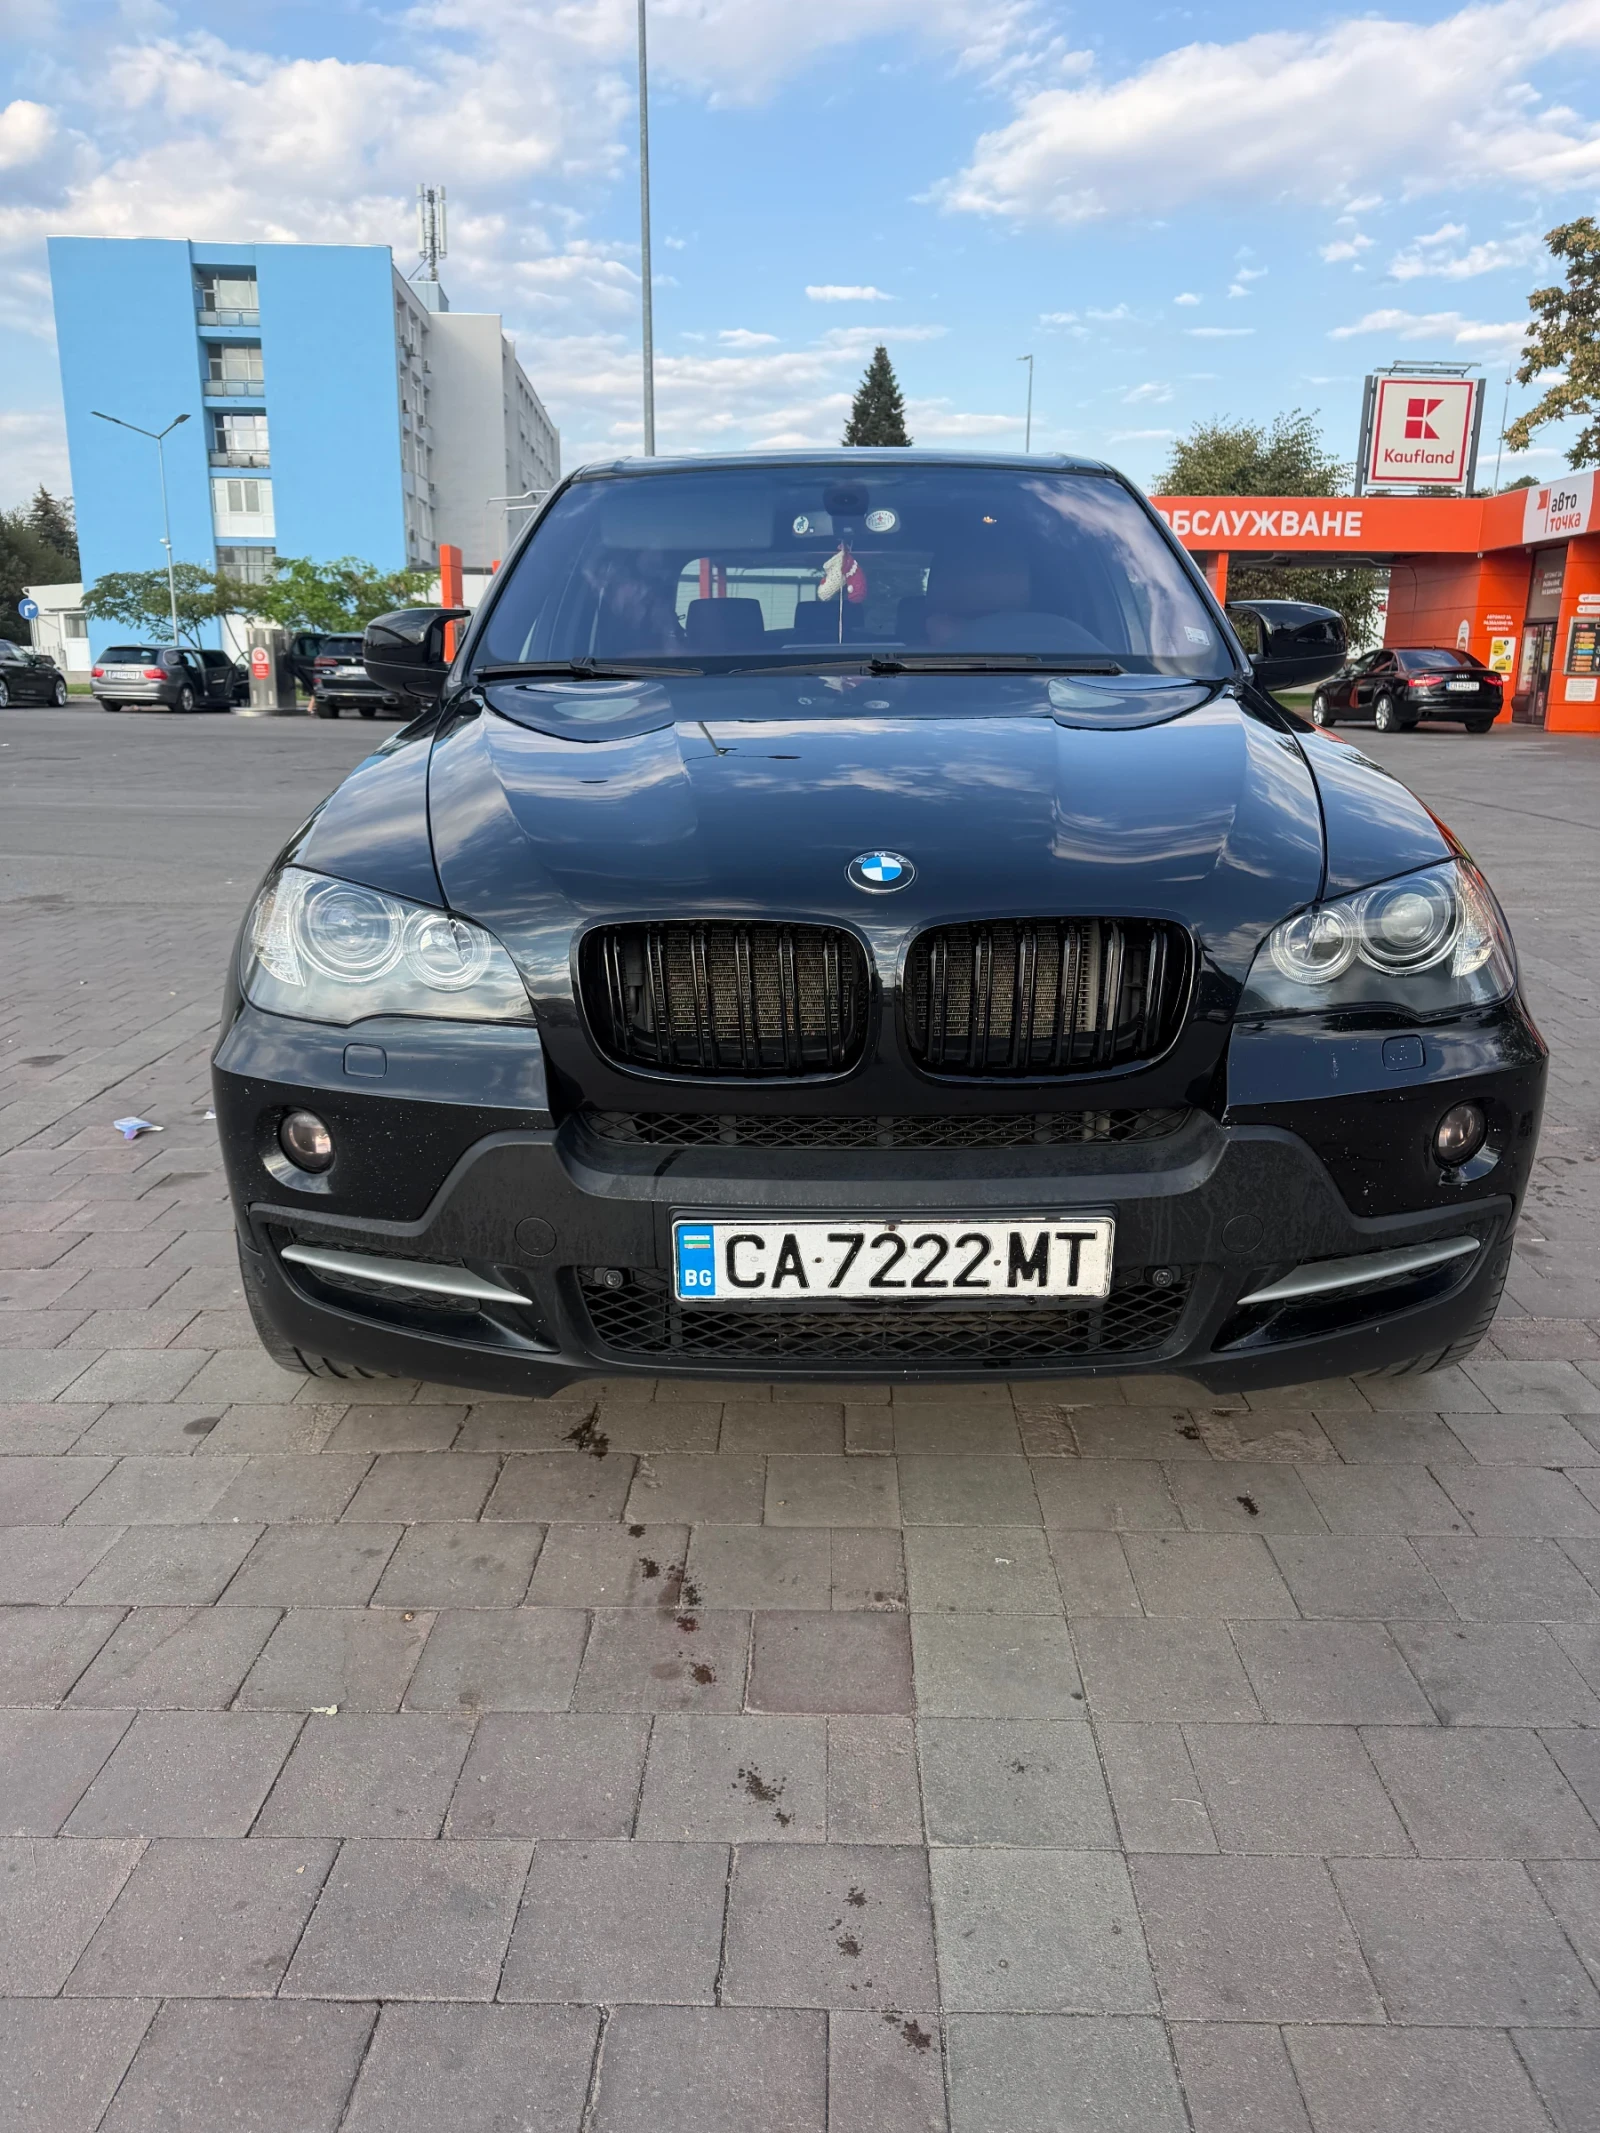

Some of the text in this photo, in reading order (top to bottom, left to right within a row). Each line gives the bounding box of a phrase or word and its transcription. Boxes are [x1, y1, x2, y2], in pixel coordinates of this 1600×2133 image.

[1384, 448, 1455, 464] Kaufland
[1551, 491, 1577, 513] авто
[1158, 510, 1363, 537] БСЛУЖВАНЕ
[1550, 512, 1581, 532] точка
[855, 852, 908, 864] BMW
[725, 1231, 1098, 1289] CA 7222 MT
[684, 1269, 713, 1288] BG
